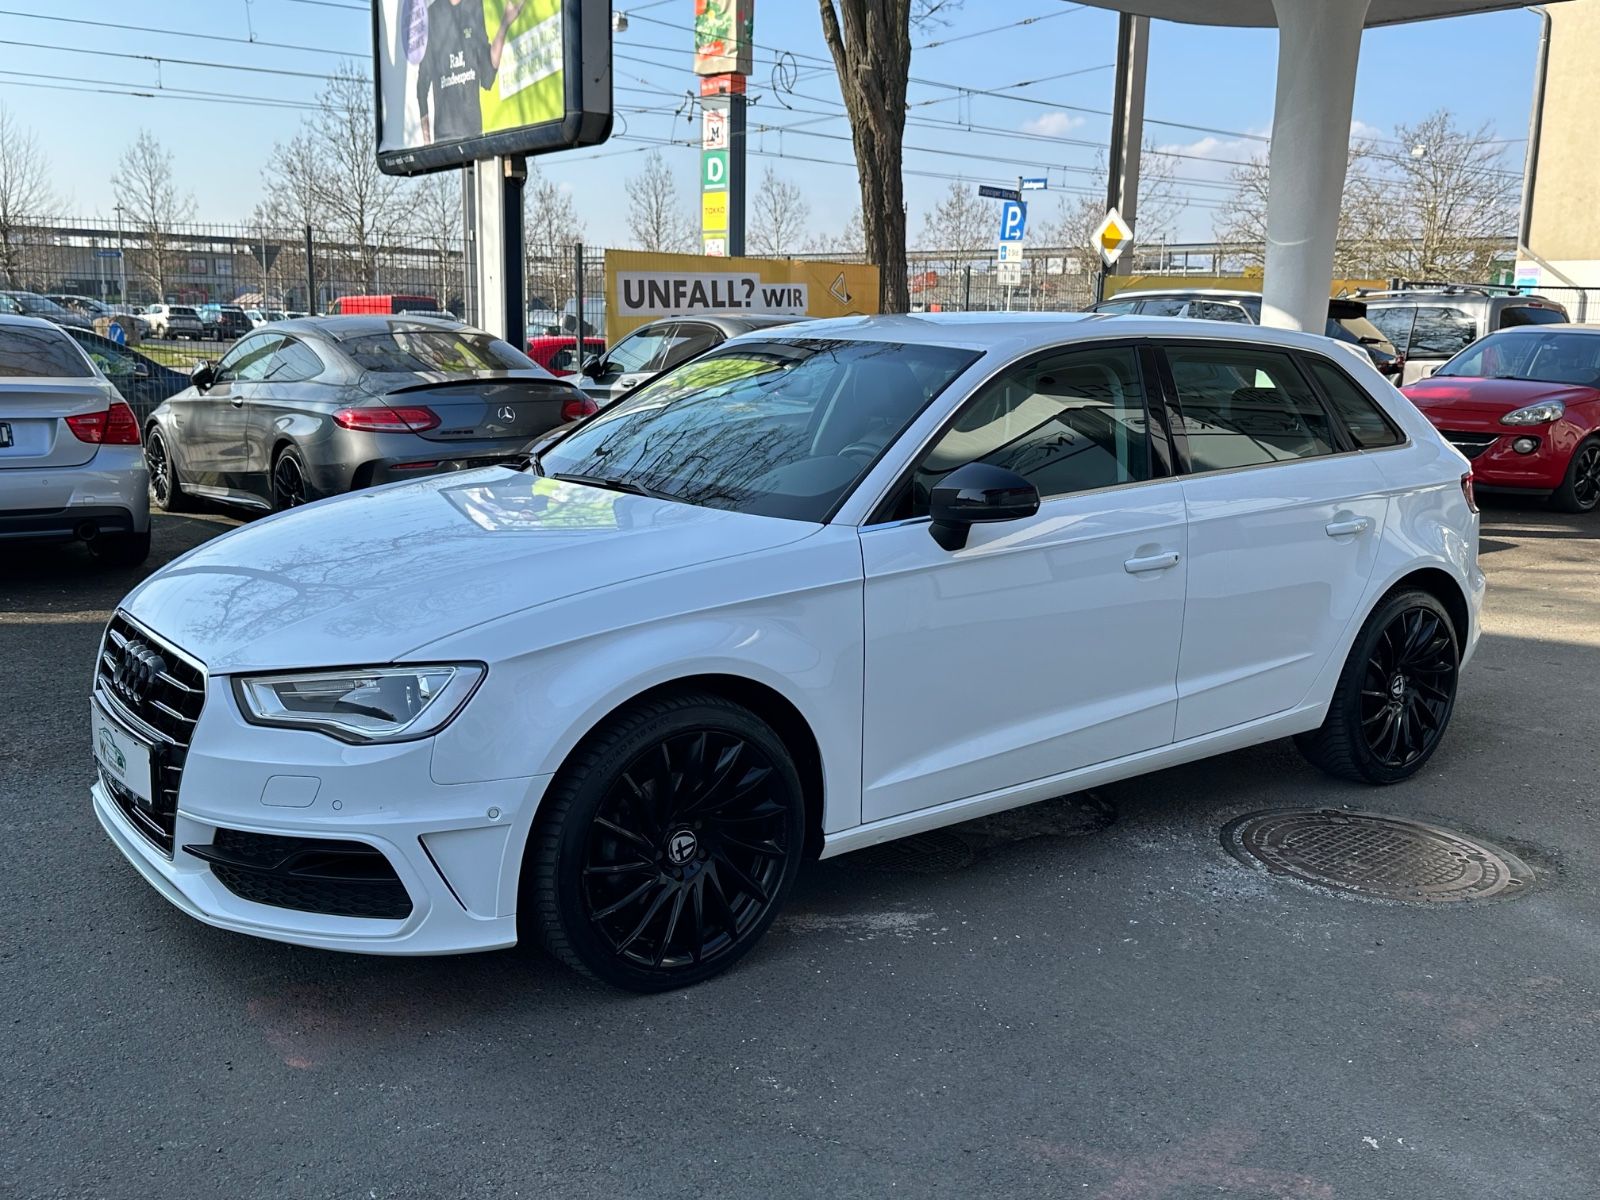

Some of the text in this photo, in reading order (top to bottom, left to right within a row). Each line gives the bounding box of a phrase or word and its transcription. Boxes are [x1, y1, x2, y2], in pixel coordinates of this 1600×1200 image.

[707, 157, 724, 182] D
[1005, 206, 1021, 238] P
[623, 278, 803, 309] UNFALL? WIR
